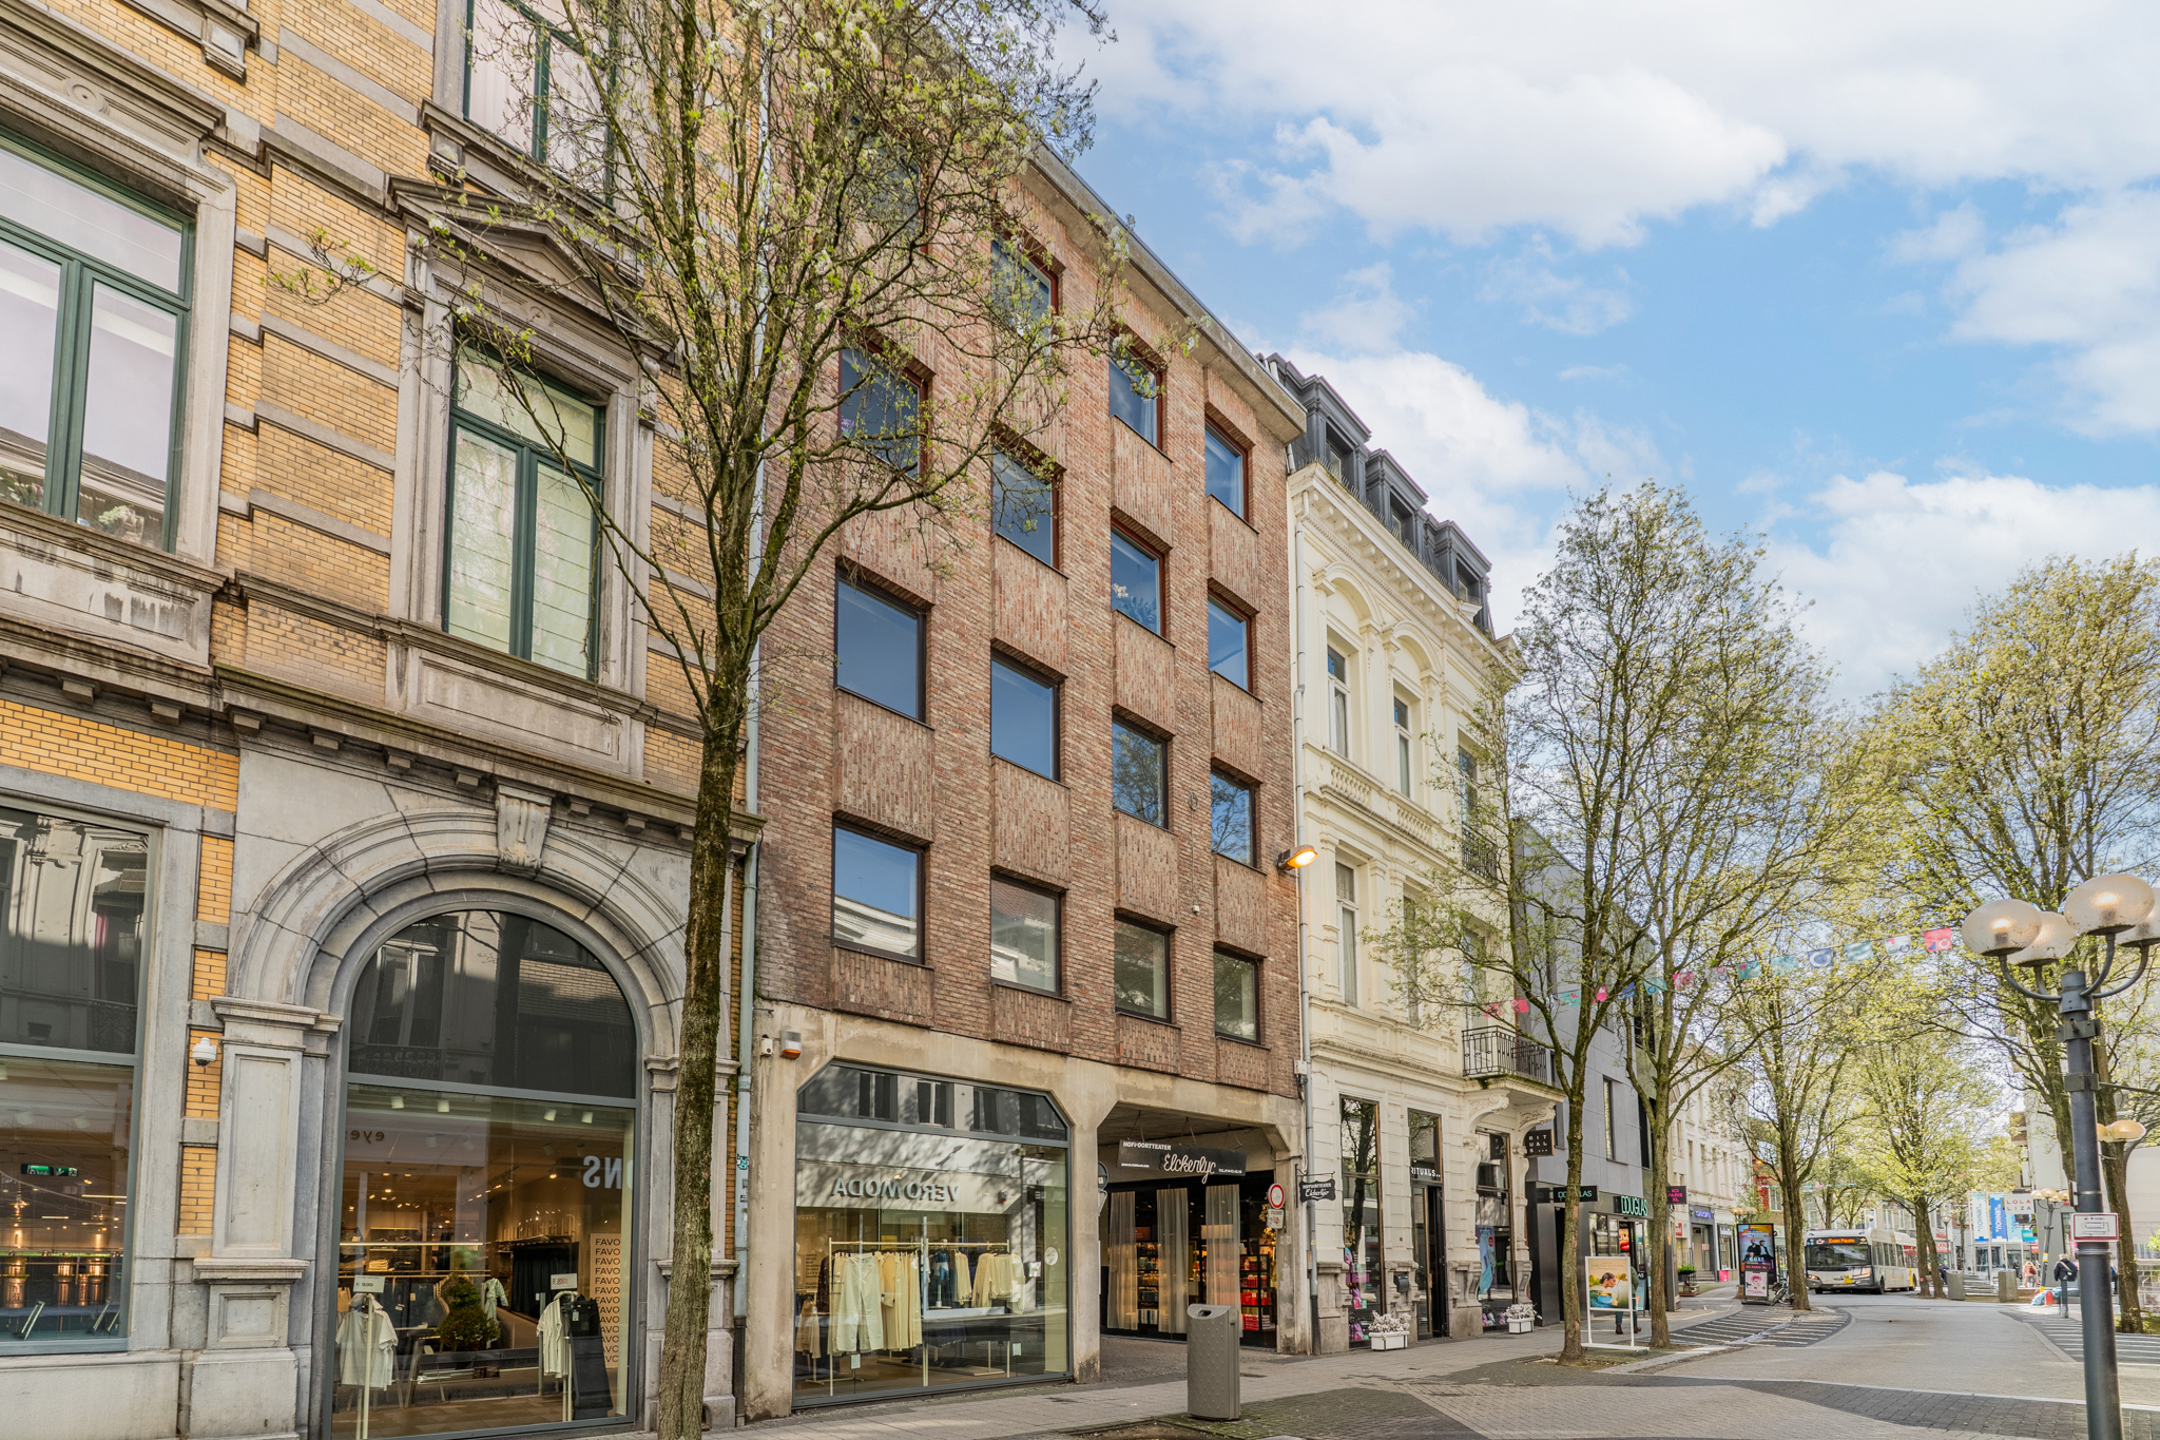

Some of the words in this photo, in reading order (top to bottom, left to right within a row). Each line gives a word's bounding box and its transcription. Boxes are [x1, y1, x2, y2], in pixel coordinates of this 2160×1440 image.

[1163, 1153, 1217, 1185] Elckerlyc
[1557, 1190, 1593, 1199] DOLAS
[1620, 1195, 1649, 1217] DOUGLAS
[595, 1238, 620, 1246] FAVO
[595, 1247, 620, 1255] FAVO
[595, 1257, 620, 1265] FAVO
[595, 1267, 620, 1275] FAVO
[595, 1276, 620, 1284] FAVO
[595, 1286, 620, 1294] FAVO
[599, 1305, 620, 1313] AVO
[600, 1315, 620, 1323] AVO
[601, 1325, 619, 1333] AVO
[602, 1335, 619, 1343] AVO
